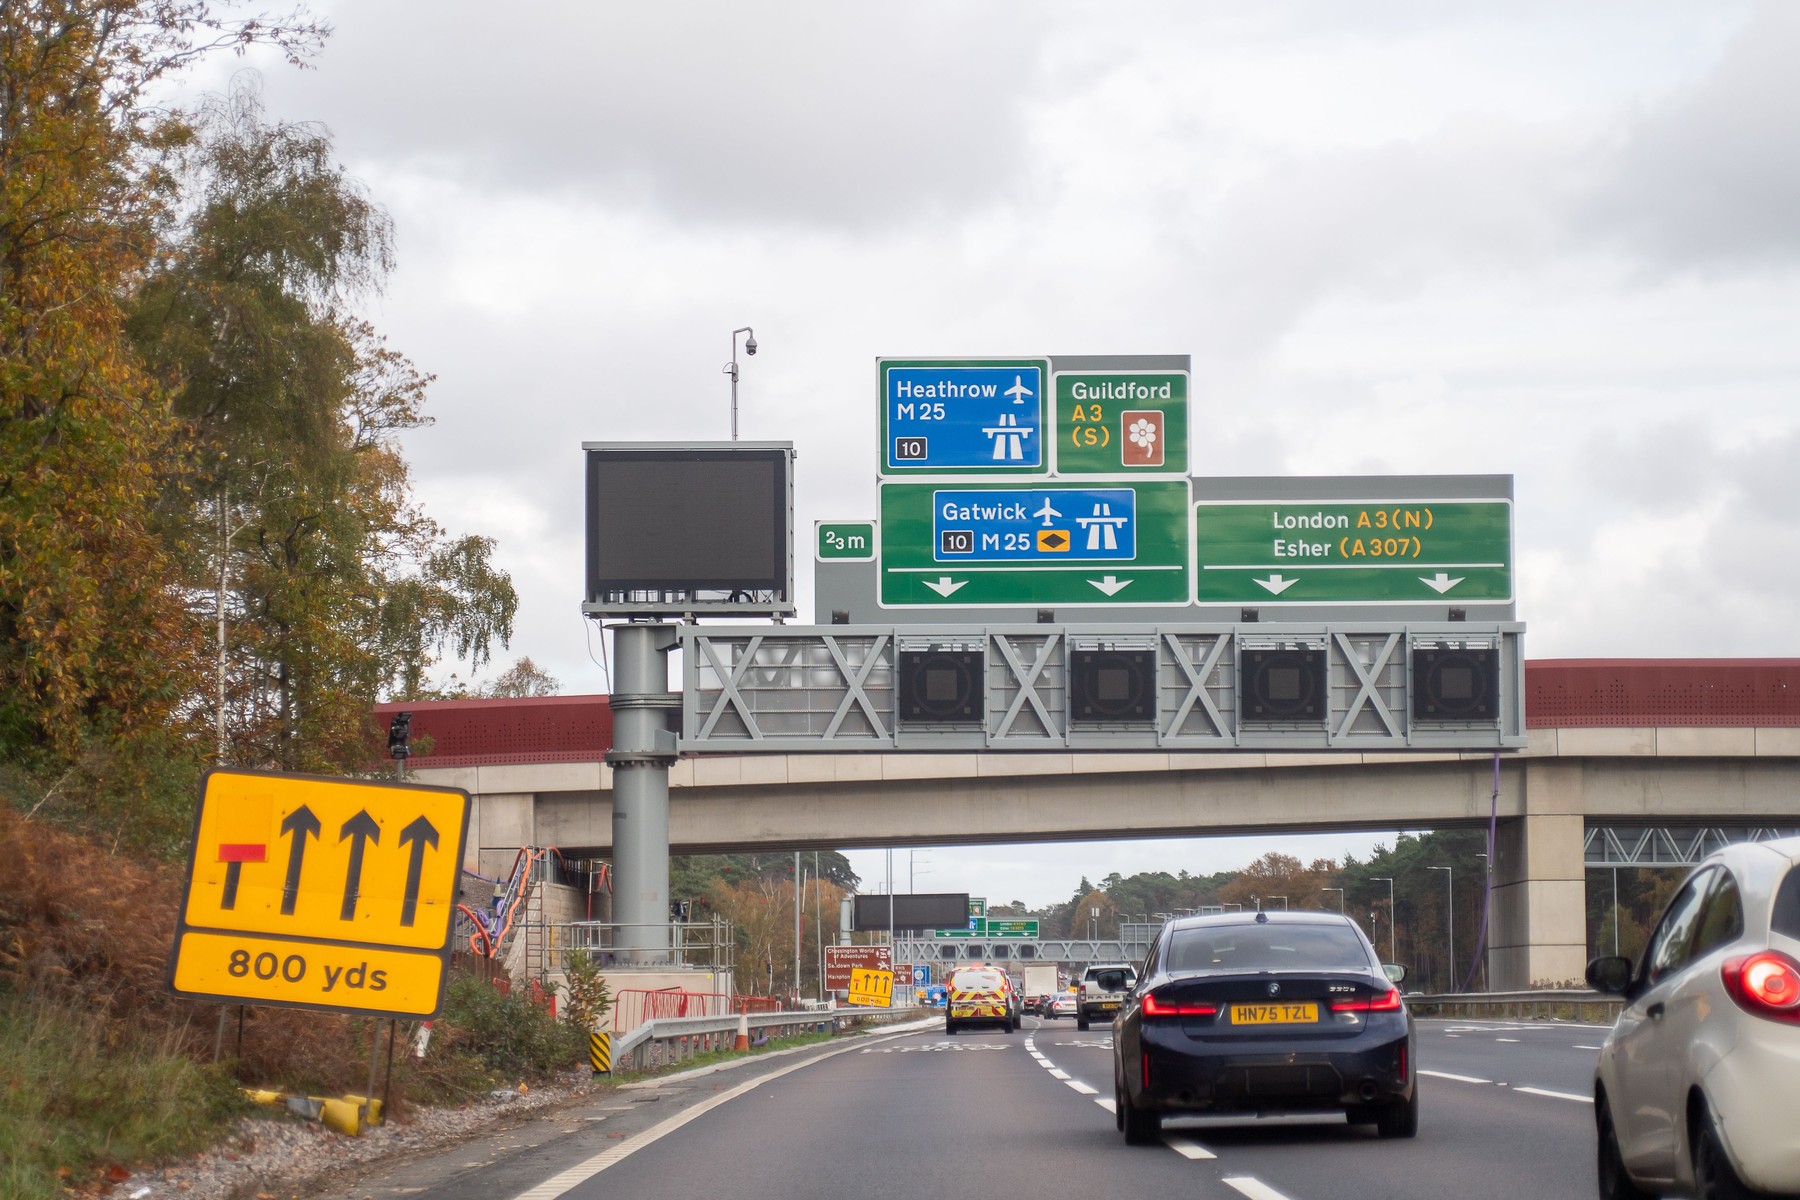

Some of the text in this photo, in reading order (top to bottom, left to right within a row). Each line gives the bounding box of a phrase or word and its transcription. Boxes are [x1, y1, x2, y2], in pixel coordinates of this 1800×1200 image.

[897, 380, 997, 398] Heathrow
[1071, 381, 1171, 400] Guildford
[1072, 425, 1110, 448] (S)
[902, 441, 921, 456] 10
[942, 503, 1027, 521] Gatwick
[1273, 511, 1349, 529] London
[948, 535, 968, 550] 10
[1274, 539, 1332, 557] Esher
[227, 949, 388, 993] 800 yds
[1237, 1005, 1312, 1021] HN75 TZL
